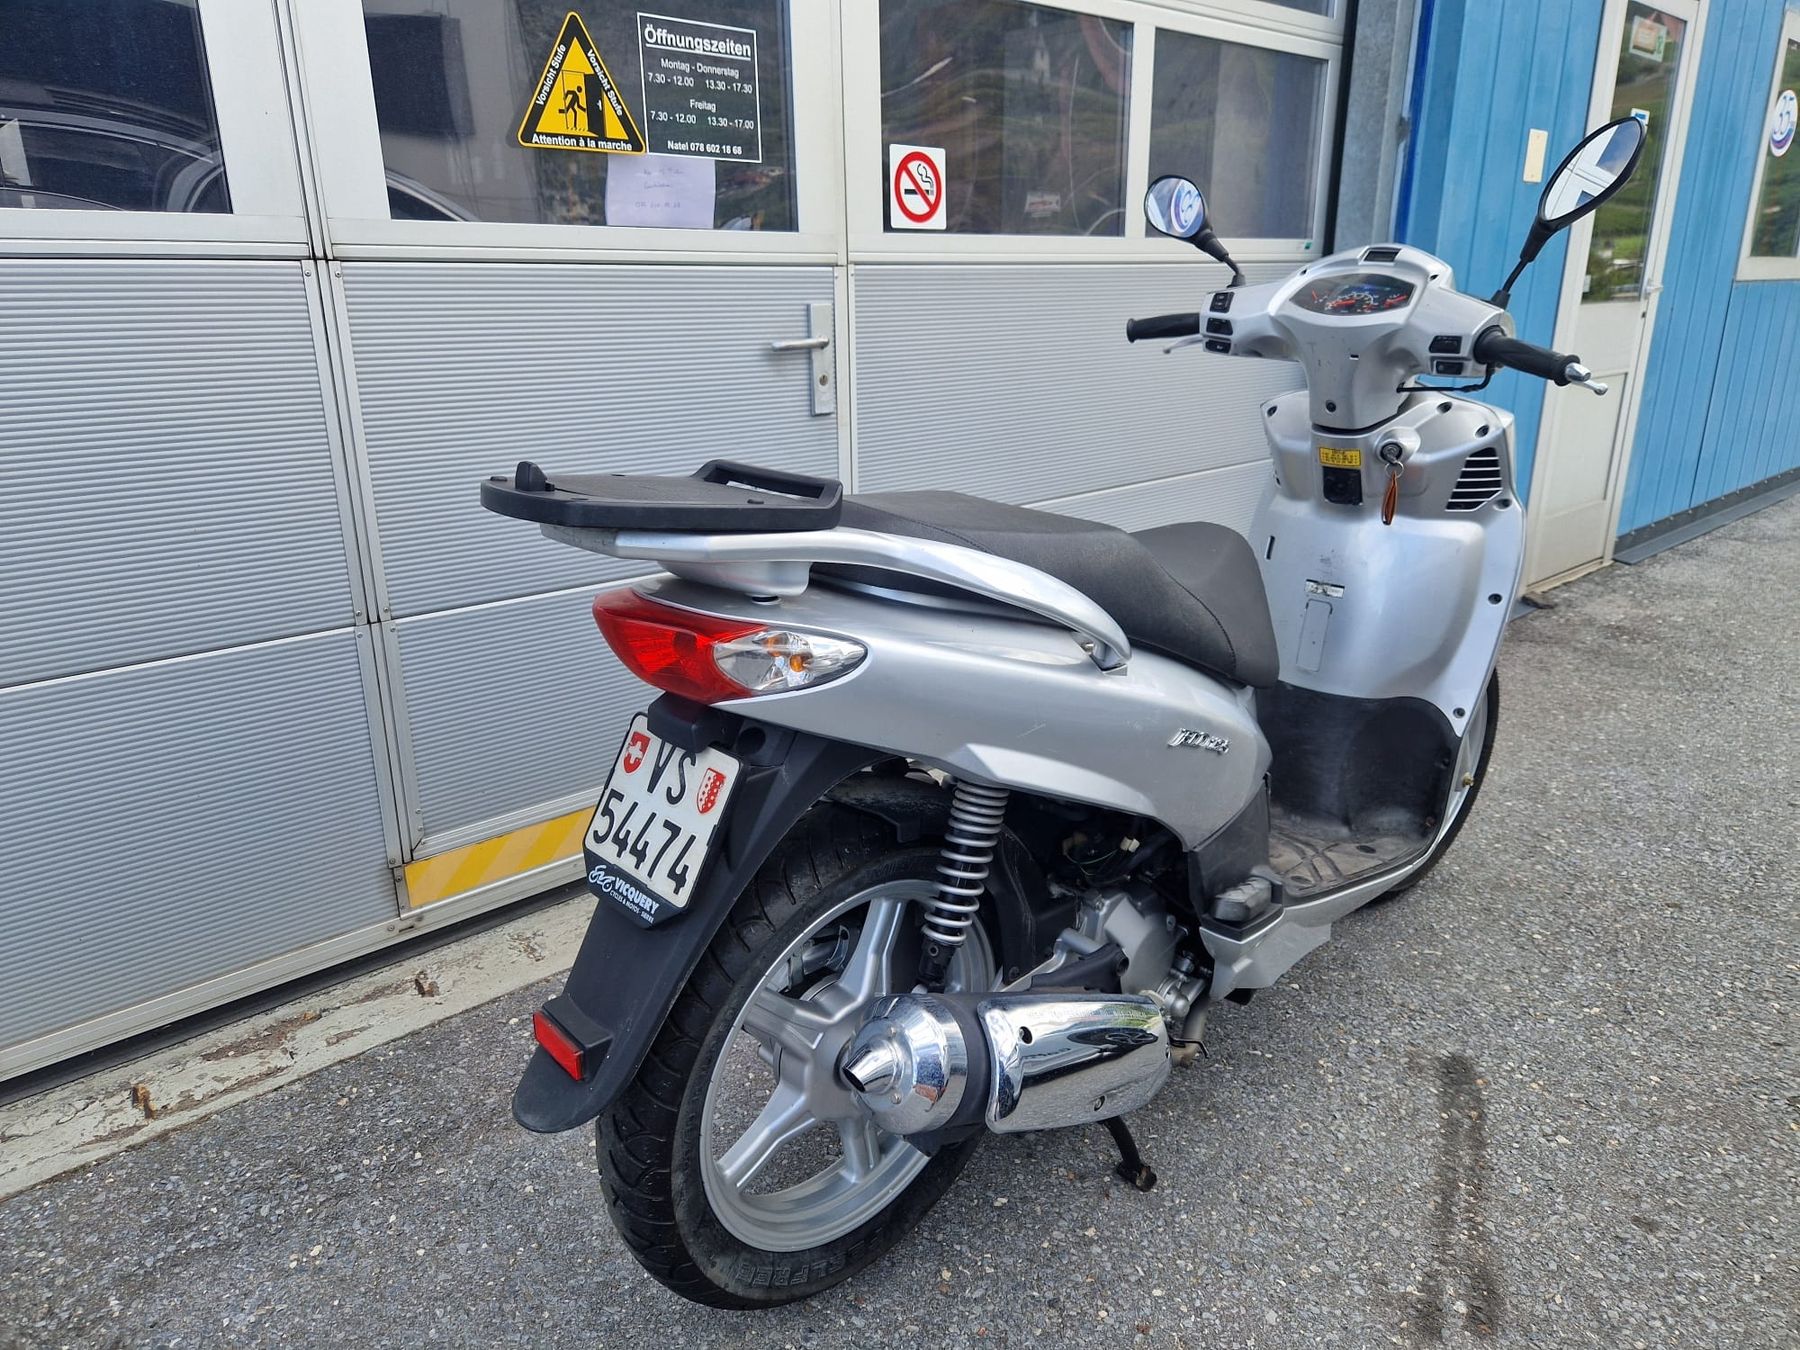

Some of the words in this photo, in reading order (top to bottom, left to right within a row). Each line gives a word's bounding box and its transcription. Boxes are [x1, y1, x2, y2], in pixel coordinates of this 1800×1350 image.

[644, 23, 751, 57] Öffnungszeiten
[536, 69, 557, 106] Vorsicht
[551, 44, 566, 69] Stufe
[661, 58, 690, 73] Montag
[696, 62, 740, 79] Donnerstag
[587, 48, 611, 92] Vorsicht
[607, 90, 623, 116] Stufe
[648, 72, 666, 84] 7.30
[673, 76, 694, 87] 12.00
[705, 79, 726, 91] 13.30
[732, 82, 753, 94] 17.30
[689, 99, 716, 112] Freitag
[650, 110, 668, 121] 7.30
[675, 113, 697, 124] 12.00
[707, 116, 728, 127] 13.30
[734, 119, 754, 130] 17.00
[532, 133, 577, 147] Attention
[579, 135, 585, 147] à
[587, 137, 596, 148] la
[598, 139, 632, 151] marche
[667, 140, 688, 151] Natel
[690, 142, 705, 152] 078
[722, 145, 731, 154] 18
[647, 740, 698, 805] VS
[593, 789, 696, 895] 54474
[614, 877, 660, 915] VICQUERY
